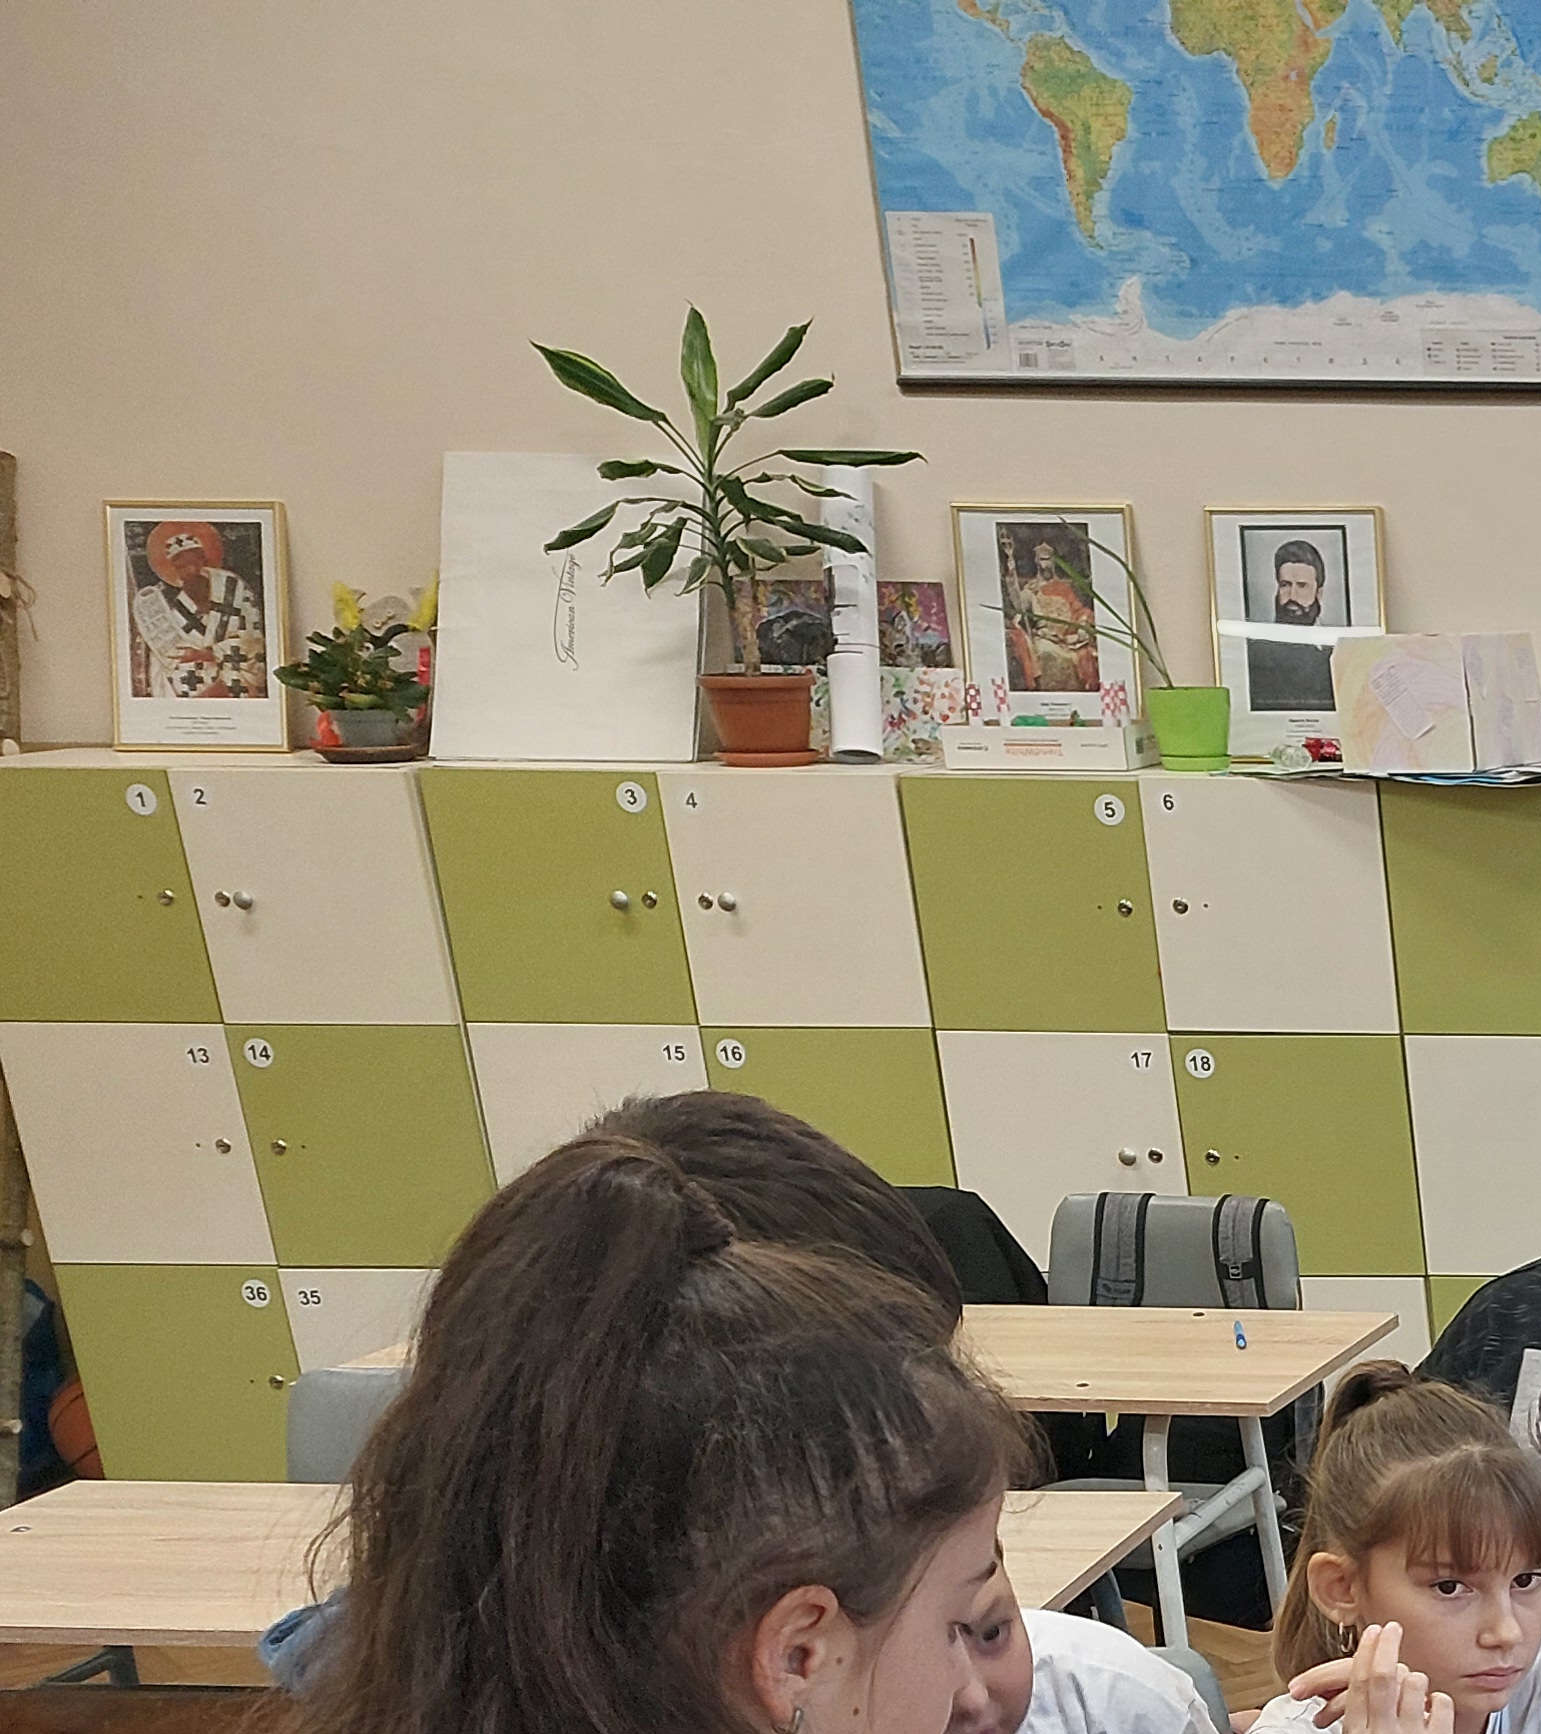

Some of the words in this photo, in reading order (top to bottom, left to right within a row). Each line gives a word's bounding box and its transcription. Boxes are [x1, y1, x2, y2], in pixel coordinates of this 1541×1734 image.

[136, 791, 146, 807] 1
[193, 788, 207, 805] 2
[624, 789, 637, 806] 3
[686, 792, 698, 808] 4
[1163, 794, 1174, 811] 6
[1104, 801, 1116, 818] 5
[187, 1047, 210, 1064] 13
[248, 1044, 271, 1061] 14
[663, 1045, 685, 1062] 15
[720, 1045, 743, 1062] 16
[1131, 1052, 1152, 1068] 17
[1189, 1055, 1211, 1072] 18
[244, 1285, 267, 1302] 36
[298, 1290, 321, 1306] 35
